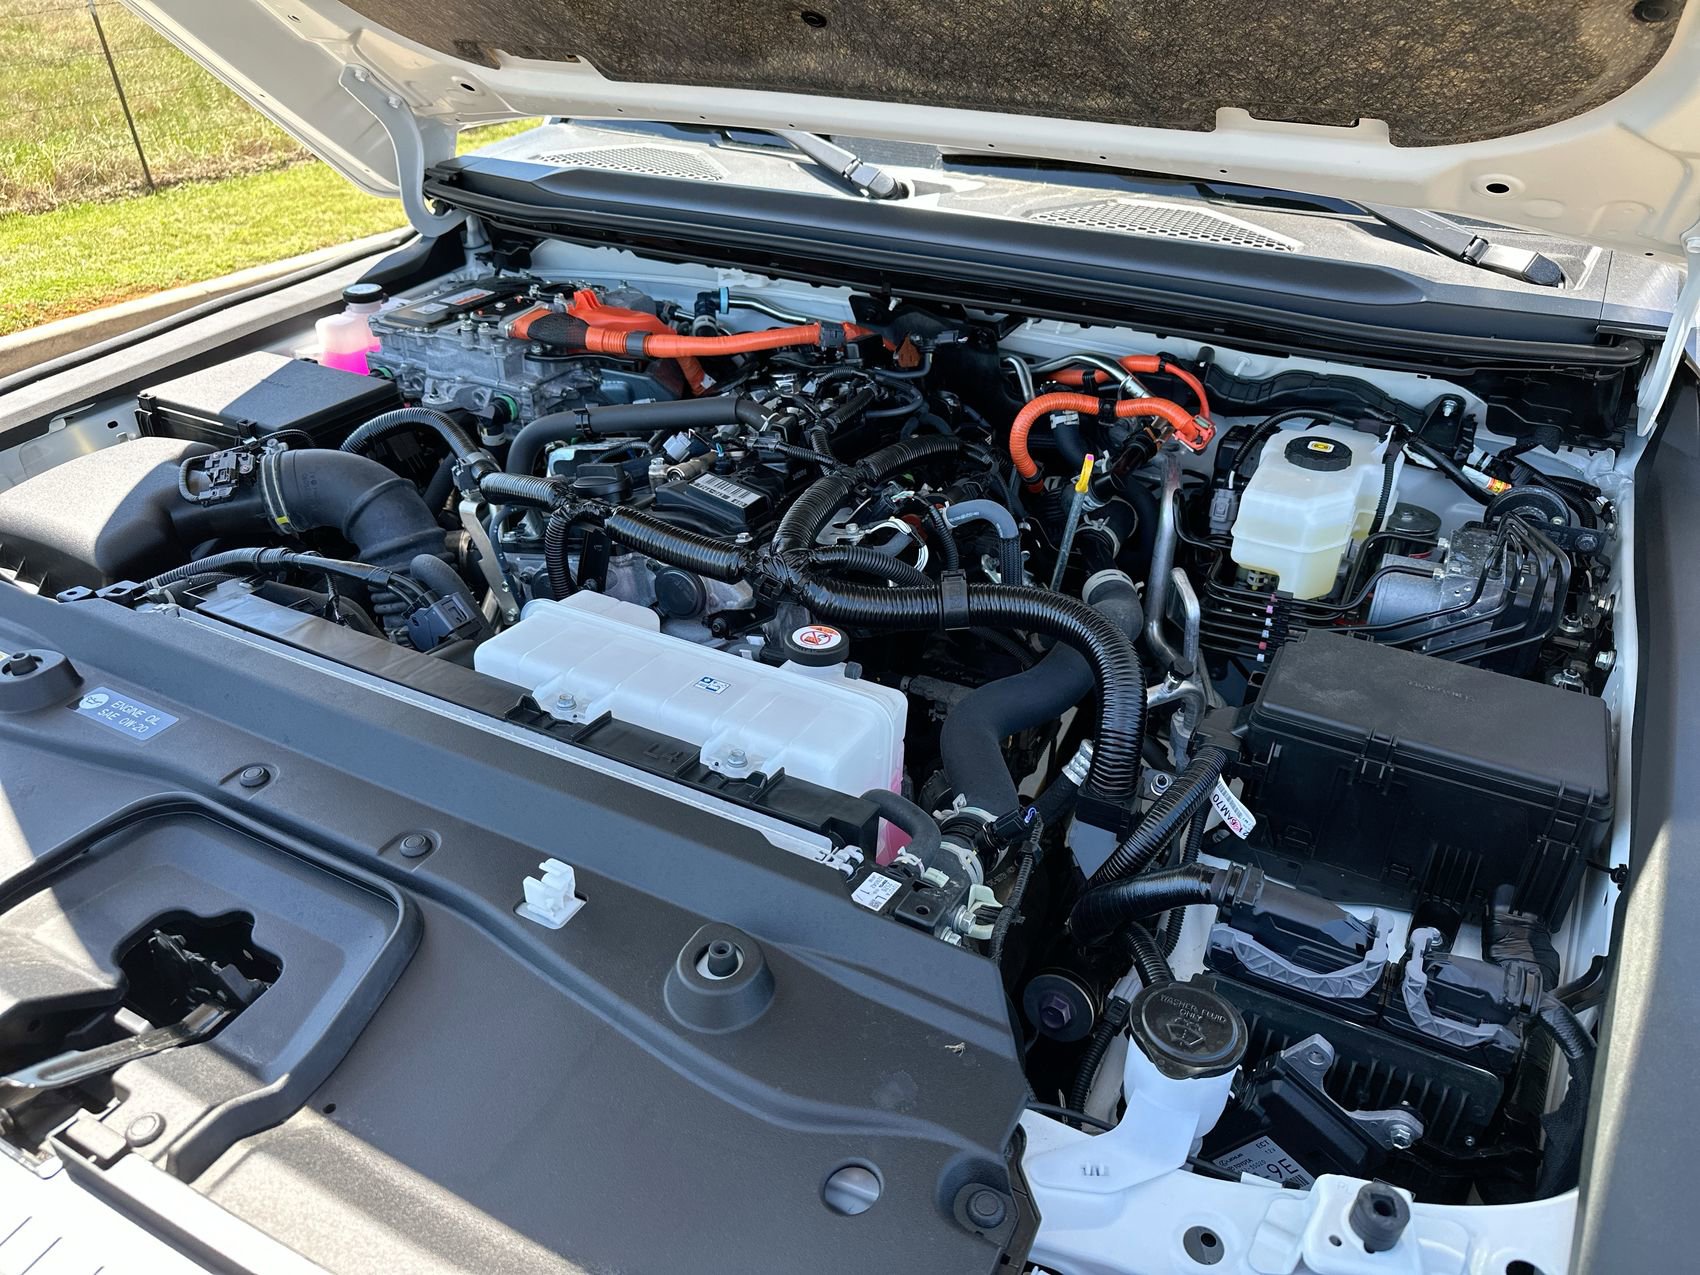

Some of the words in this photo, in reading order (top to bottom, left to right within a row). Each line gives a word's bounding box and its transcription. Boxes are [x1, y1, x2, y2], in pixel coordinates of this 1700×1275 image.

[97, 708, 120, 721] SAE
[119, 717, 149, 733] 0W-20
[111, 700, 147, 718] ENGINE
[144, 714, 161, 726] OIL
[1160, 993, 1199, 1012] WASHER
[1201, 1008, 1227, 1023] FLUID
[1180, 1008, 1203, 1021] ONLY
[1255, 1139, 1270, 1149] ECT
[1234, 1158, 1253, 1170] TOYOTA
